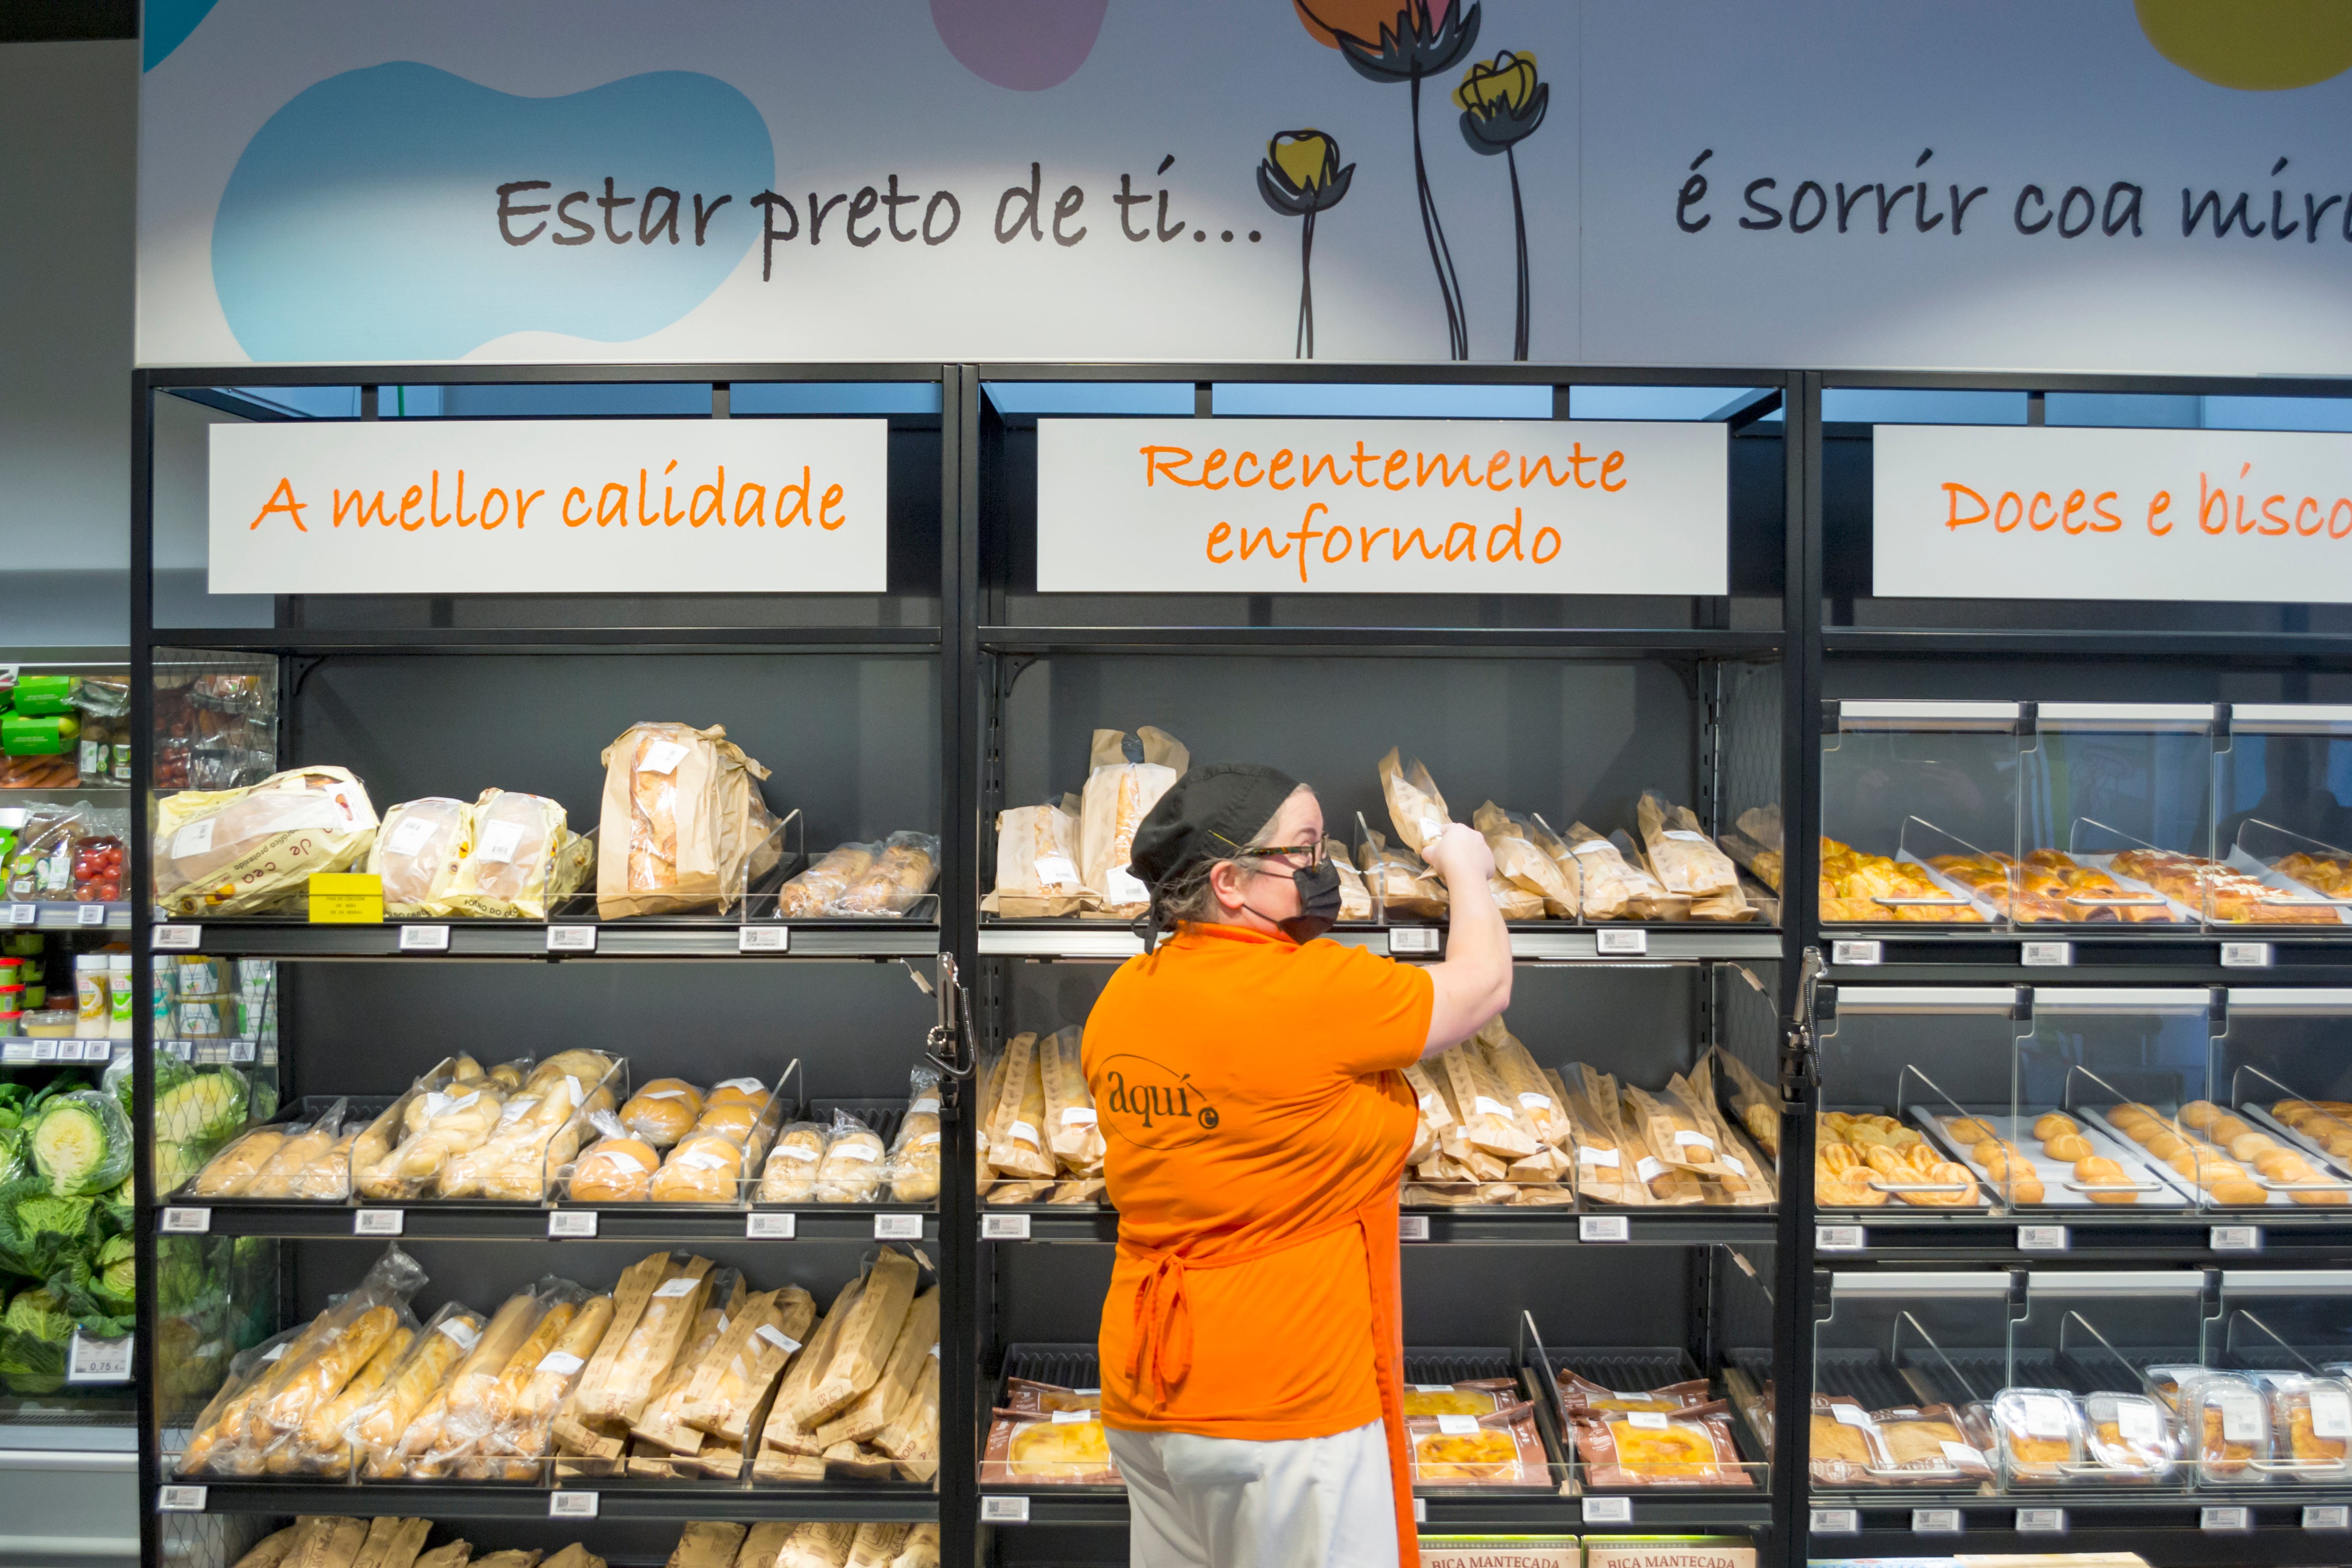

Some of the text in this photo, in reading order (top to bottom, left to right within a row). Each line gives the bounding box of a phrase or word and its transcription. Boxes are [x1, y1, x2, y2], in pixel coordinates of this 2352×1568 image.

[496, 176, 733, 247] Estar
[749, 174, 961, 282] preto
[994, 161, 1086, 247] de
[1676, 148, 1713, 234] é
[2013, 180, 2144, 239] coa
[1138, 440, 1628, 493] Recentemente
[250, 477, 308, 533] A
[332, 469, 546, 532] mellor
[1940, 481, 2123, 535] Doces
[2146, 489, 2174, 537] e
[1205, 501, 1562, 584] enfornado
[464, 899, 487, 912] FORNO
[489, 907, 501, 916] DO
[1107, 1071, 1192, 1128] aquí
[90, 1362, 111, 1371] 0,75
[1431, 1555, 1560, 1568] BICA MANTECADA
[1606, 1555, 1735, 1568] BICA MANTECADA
